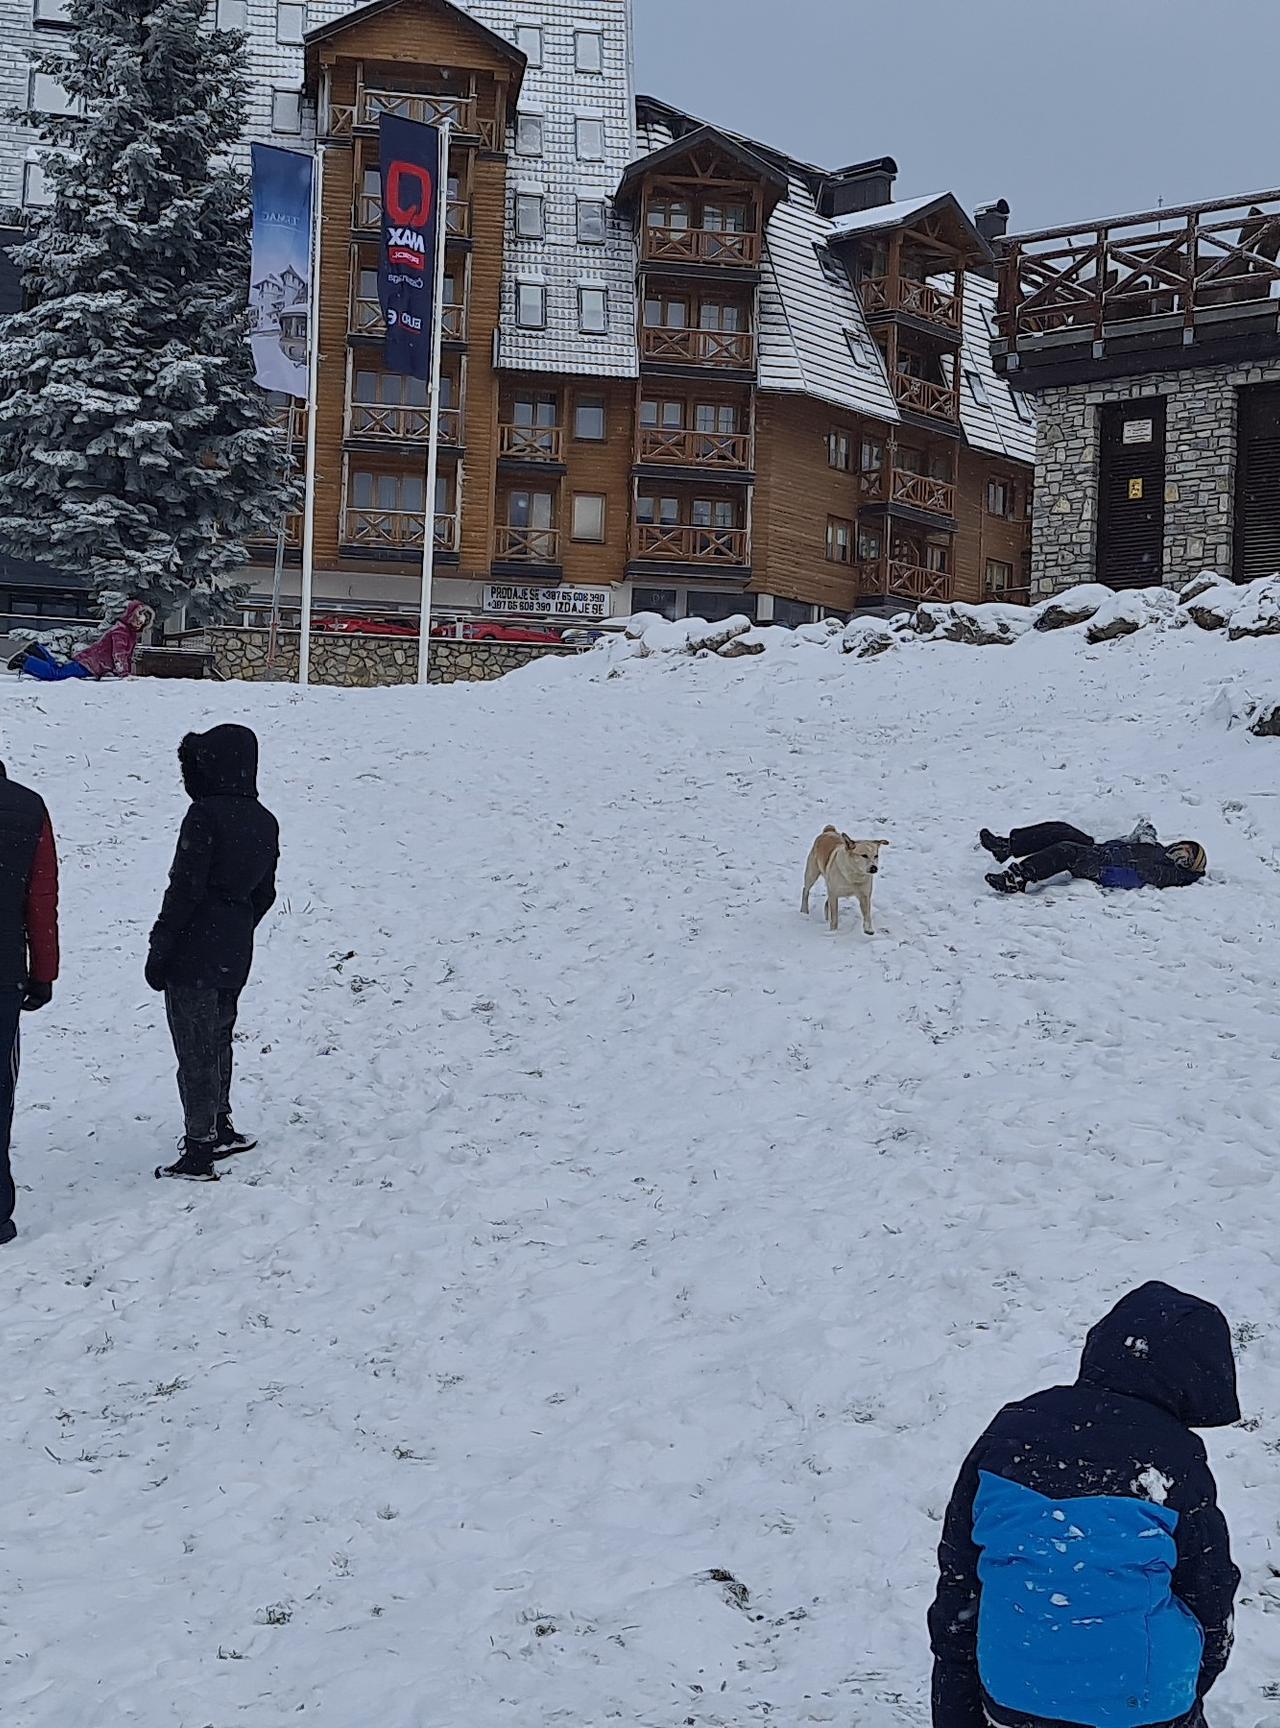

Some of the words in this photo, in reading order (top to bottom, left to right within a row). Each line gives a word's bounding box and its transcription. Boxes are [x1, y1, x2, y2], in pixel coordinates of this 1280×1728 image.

[562, 591, 572, 601] 65
[589, 593, 605, 602] 390
[535, 602, 551, 611] 390
[555, 602, 590, 613] IZDAJE
[592, 603, 604, 615] SE
